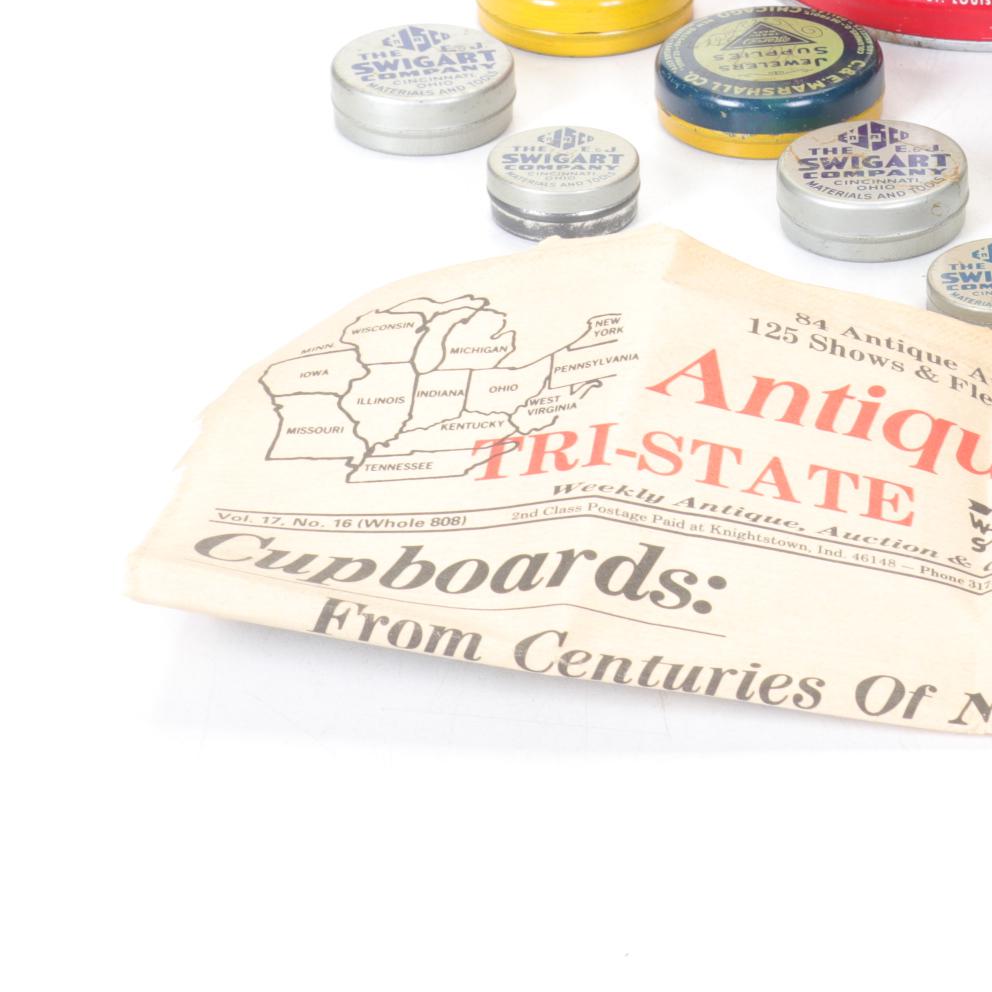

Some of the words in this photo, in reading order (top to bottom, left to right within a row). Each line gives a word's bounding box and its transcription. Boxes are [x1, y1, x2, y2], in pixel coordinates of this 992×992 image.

[359, 51, 402, 61] THE
[712, 46, 829, 63] SUPPLIES
[352, 50, 497, 75] SWIGART
[718, 57, 828, 72] JEWELERS
[361, 63, 496, 82] COMPANY
[370, 83, 434, 96] MATERIALS
[439, 85, 466, 95] AND
[417, 81, 453, 89] OHIO
[808, 147, 854, 155] THE
[502, 154, 624, 164] SWIGART
[798, 154, 951, 171] SWIGART
[803, 168, 947, 179] COMPANY
[806, 180, 872, 200] MATERIALS
[877, 191, 906, 199] AND
[909, 176, 945, 193] TOOLS
[351, 321, 415, 335] WISCONSIN
[595, 317, 621, 327] NEW
[594, 327, 624, 338] YORK
[795, 312, 827, 331] 84
[841, 326, 959, 371] Antique
[449, 345, 508, 355] MICHIGAN
[748, 317, 799, 344] 125
[809, 332, 905, 373] Shows
[915, 364, 940, 384] &
[553, 353, 640, 374] PENNSYLVANIA
[299, 368, 330, 378] IOWA
[416, 388, 466, 398] INDIANA
[488, 384, 519, 393] OHIO
[356, 395, 406, 405] ILLINOIS
[528, 394, 561, 407] WEST
[527, 401, 578, 416] VIRGINIA
[286, 426, 344, 435] MISSOURI
[440, 419, 504, 431] KENTUCKY
[364, 462, 434, 472] TENNESSEE
[471, 421, 915, 527] TRI-STATE
[217, 512, 253, 524] Vol.
[262, 516, 285, 526] 17,
[293, 517, 325, 528] No.
[334, 518, 353, 528] 16
[357, 518, 425, 529] (Whole
[430, 515, 467, 528] 808)
[552, 481, 666, 504] Weekly
[672, 495, 806, 532] Antique,
[817, 525, 938, 560] Auction
[948, 553, 972, 569] &
[969, 512, 990, 535] W
[511, 508, 539, 521] 2nd
[543, 503, 583, 517] Class
[588, 501, 648, 522] Postage
[652, 514, 686, 529] Paid
[689, 522, 705, 532] at
[709, 523, 812, 554] Knightstown,
[818, 544, 847, 559] Ind.
[851, 551, 897, 569] 46148
[920, 565, 965, 586] Phone
[972, 537, 987, 552] S
[194, 533, 727, 615] Cupboards:
[306, 596, 482, 662] From
[513, 629, 826, 710] Centuries
[854, 674, 938, 720] Of
